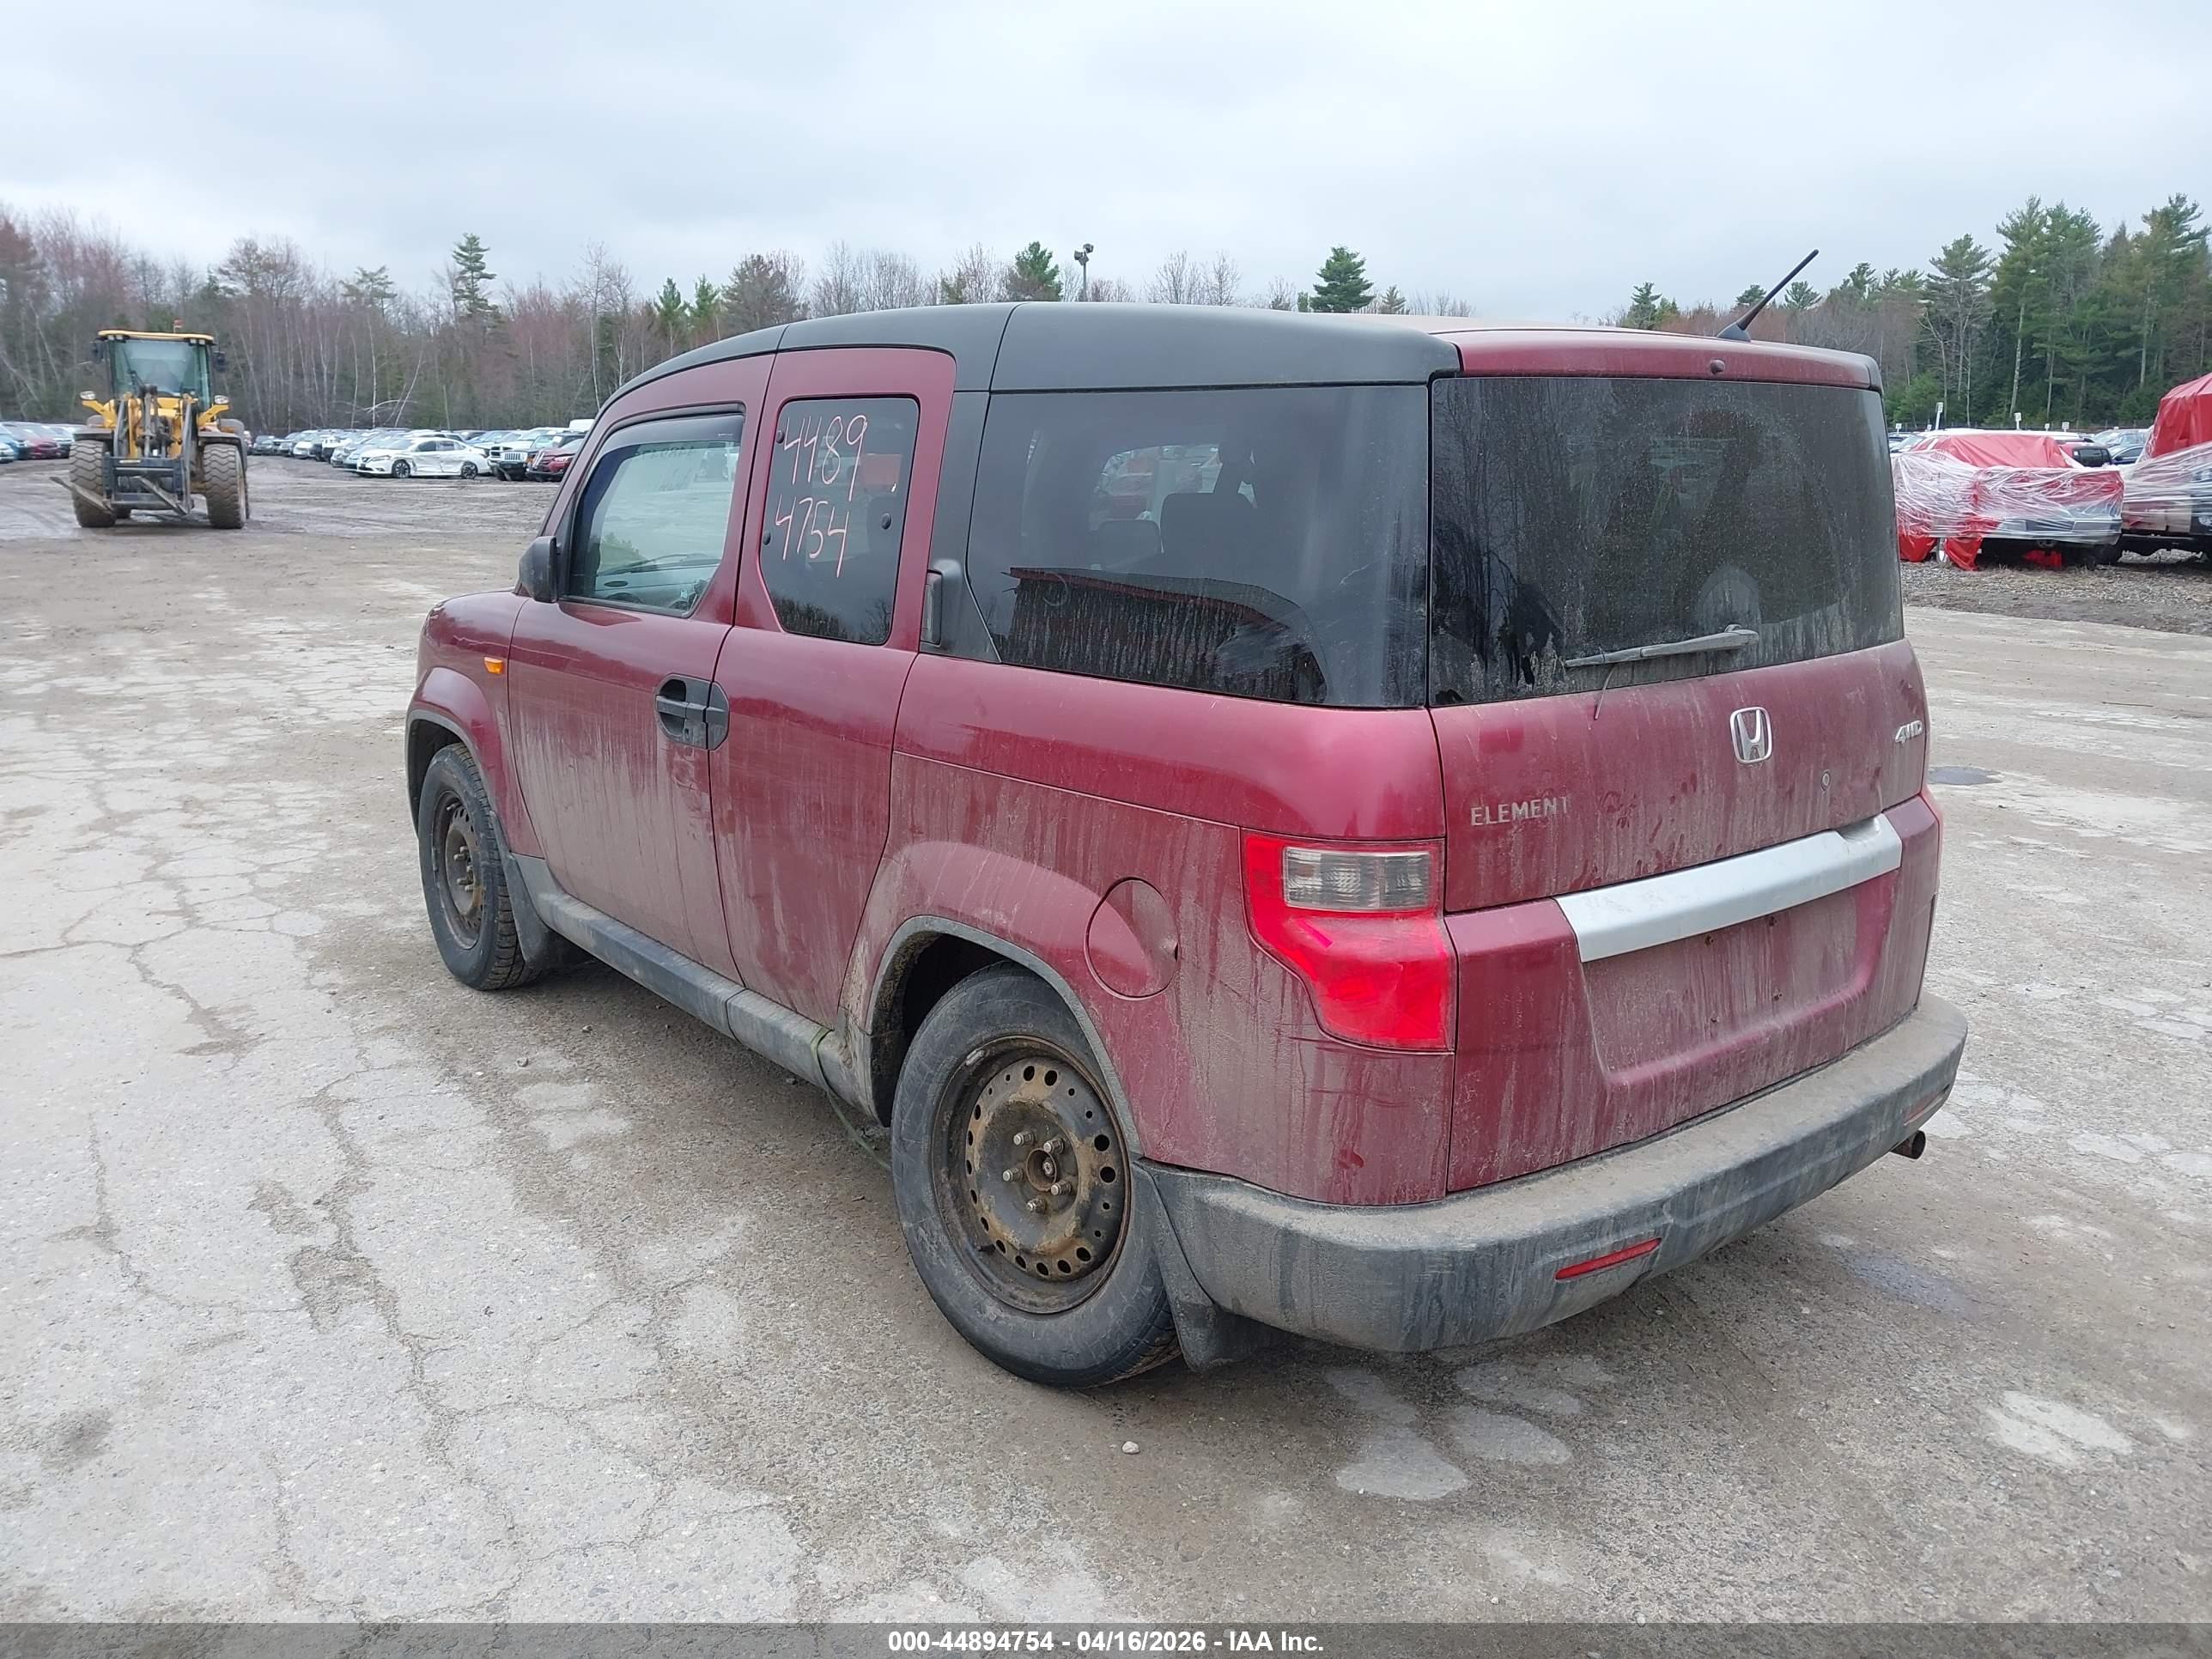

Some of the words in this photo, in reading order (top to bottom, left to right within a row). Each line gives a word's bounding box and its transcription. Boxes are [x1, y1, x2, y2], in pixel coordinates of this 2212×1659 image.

[783, 414, 868, 502] 4489
[775, 494, 850, 578] 4754
[1470, 796, 1569, 826] ELEMENT
